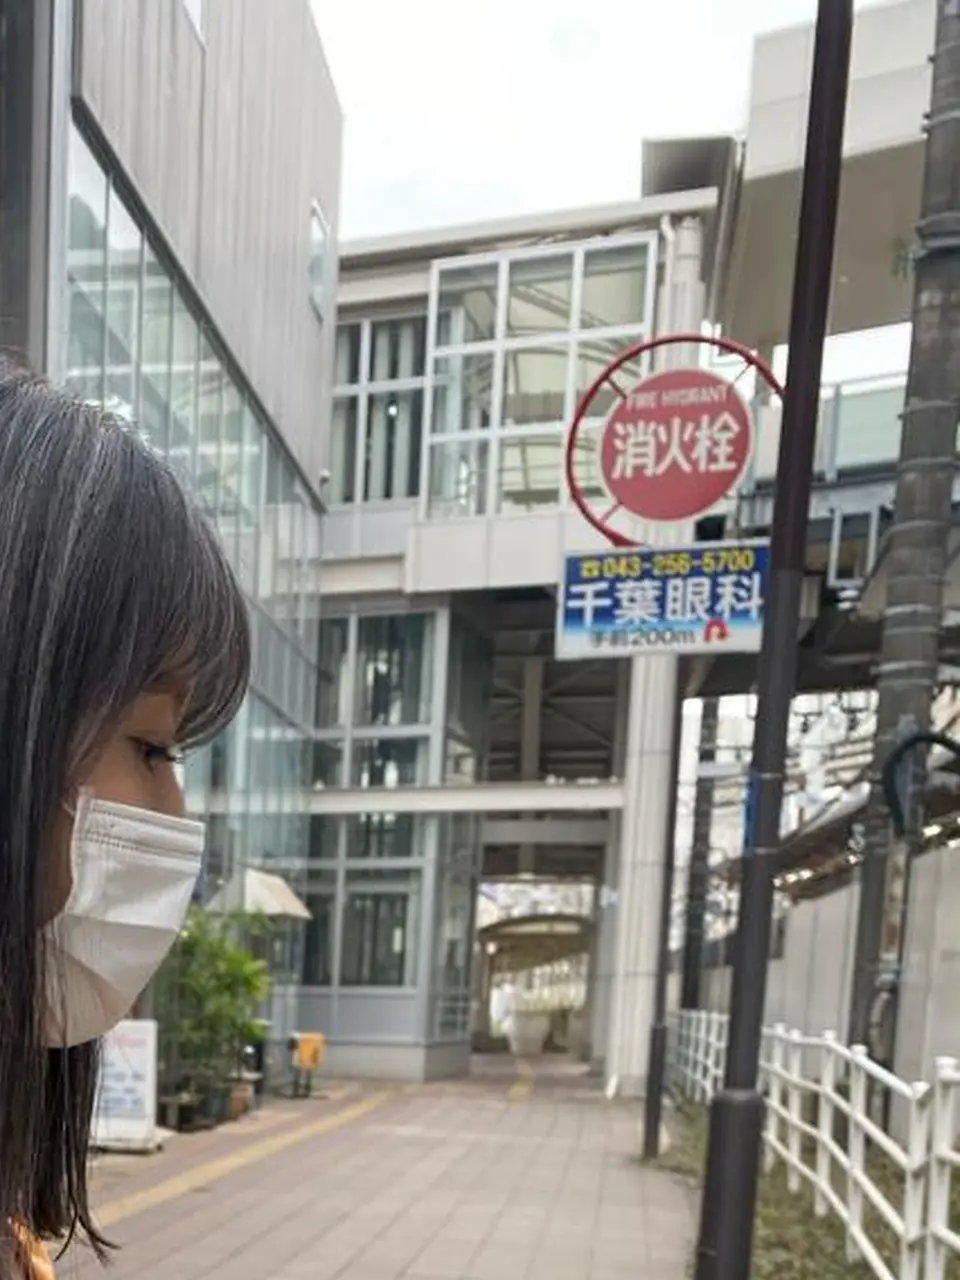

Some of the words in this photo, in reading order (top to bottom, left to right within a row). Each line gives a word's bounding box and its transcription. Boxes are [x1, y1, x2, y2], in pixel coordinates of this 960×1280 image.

[611, 411, 740, 480] 消火栓
[567, 571, 764, 626] 千葉眼科
